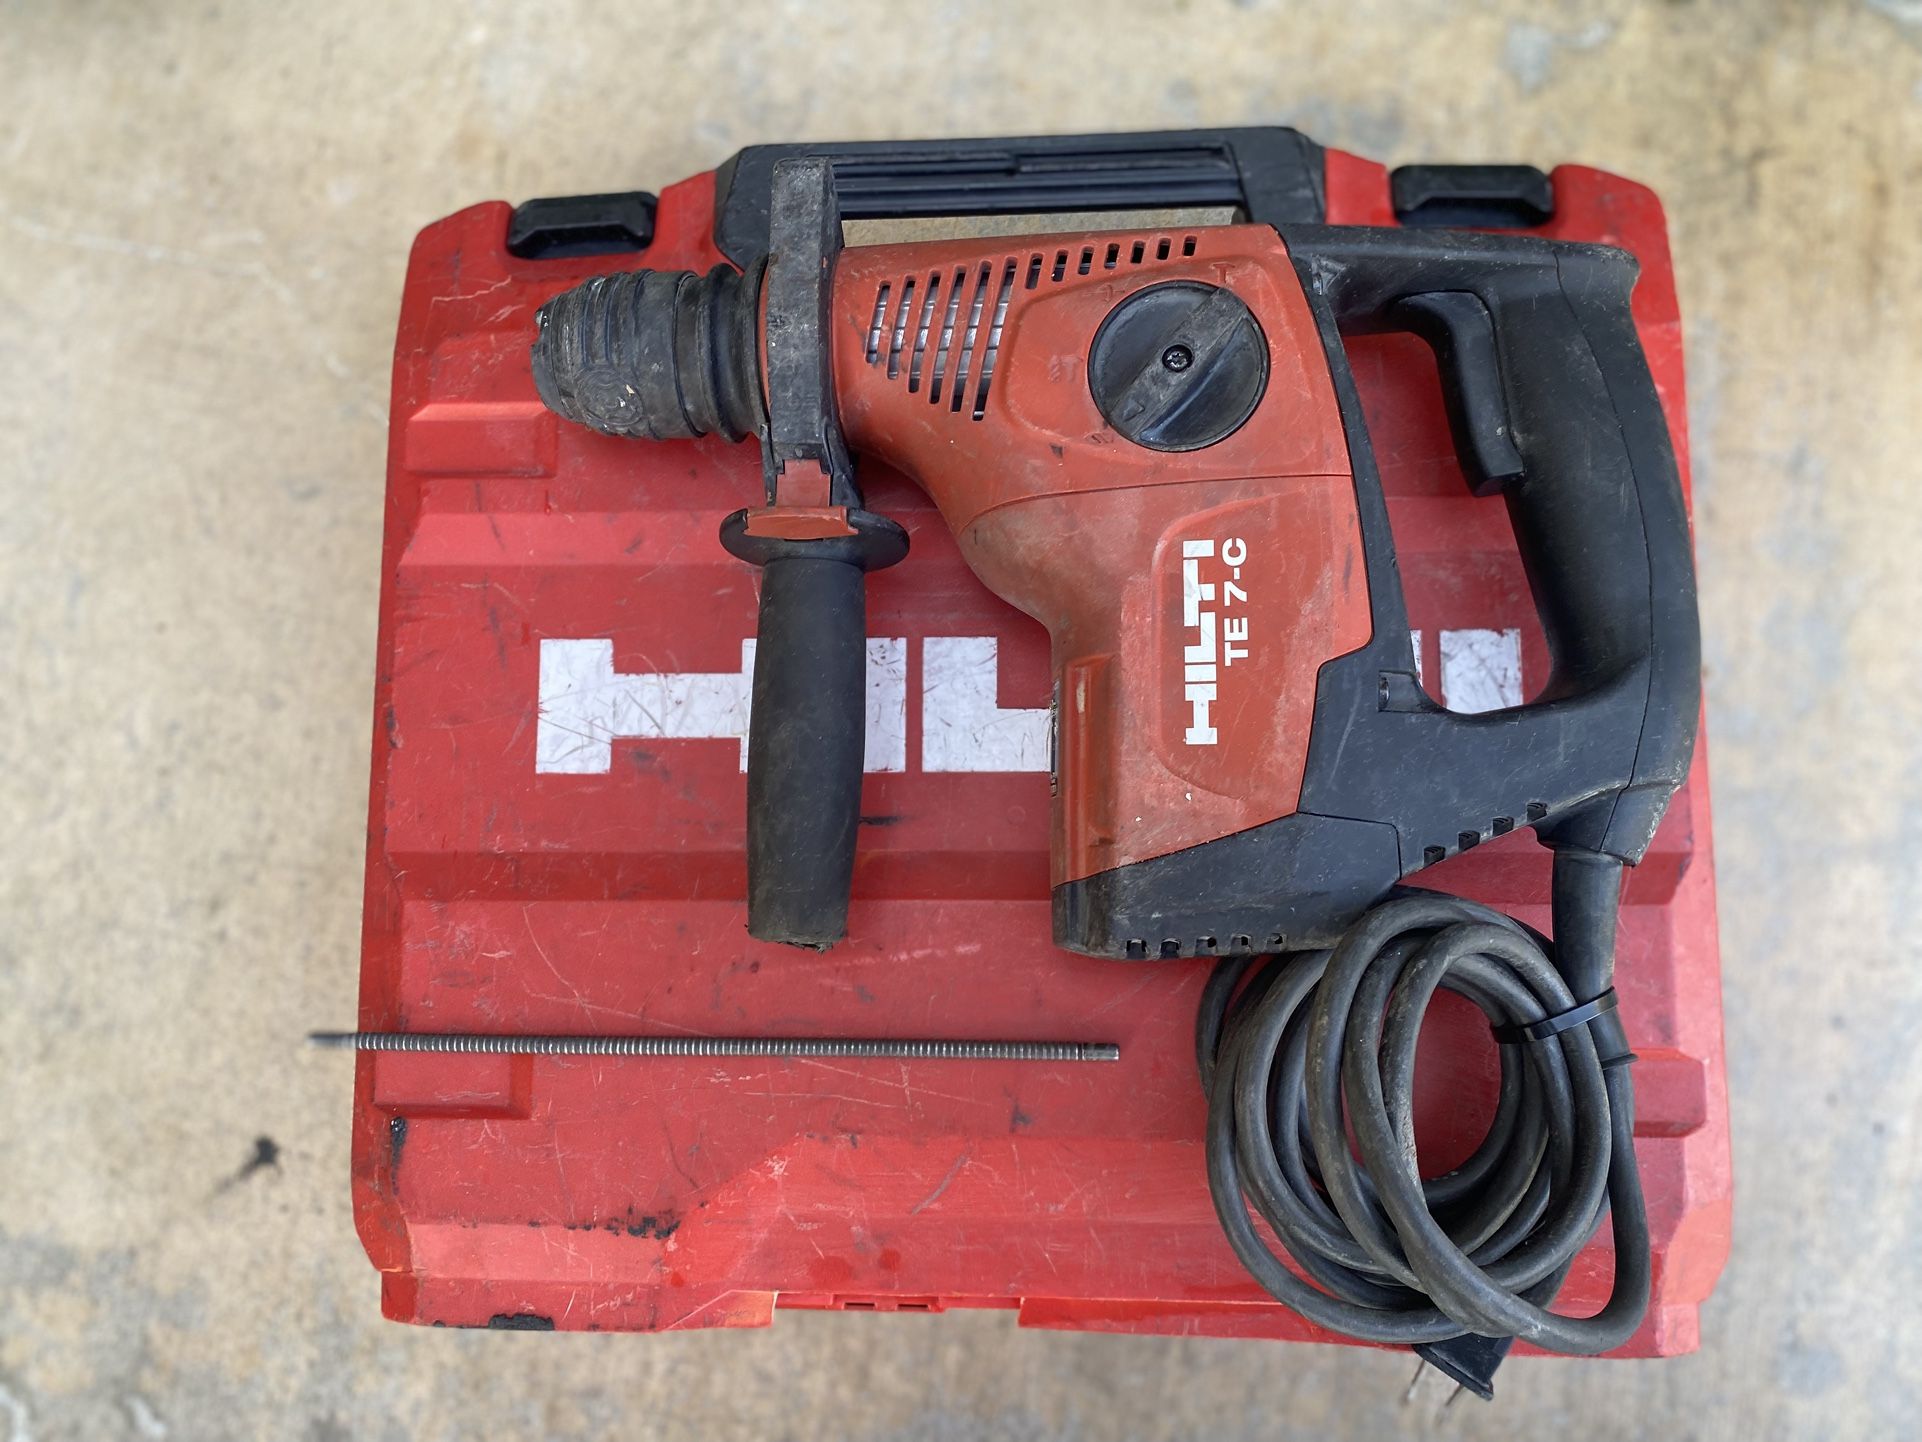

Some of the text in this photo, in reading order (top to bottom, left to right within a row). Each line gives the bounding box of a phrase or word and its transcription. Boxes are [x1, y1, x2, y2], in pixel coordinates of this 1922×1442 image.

[1183, 540, 1217, 744] HILTI
[1222, 538, 1248, 666] TE 7-C
[536, 629, 1524, 773] HILI
